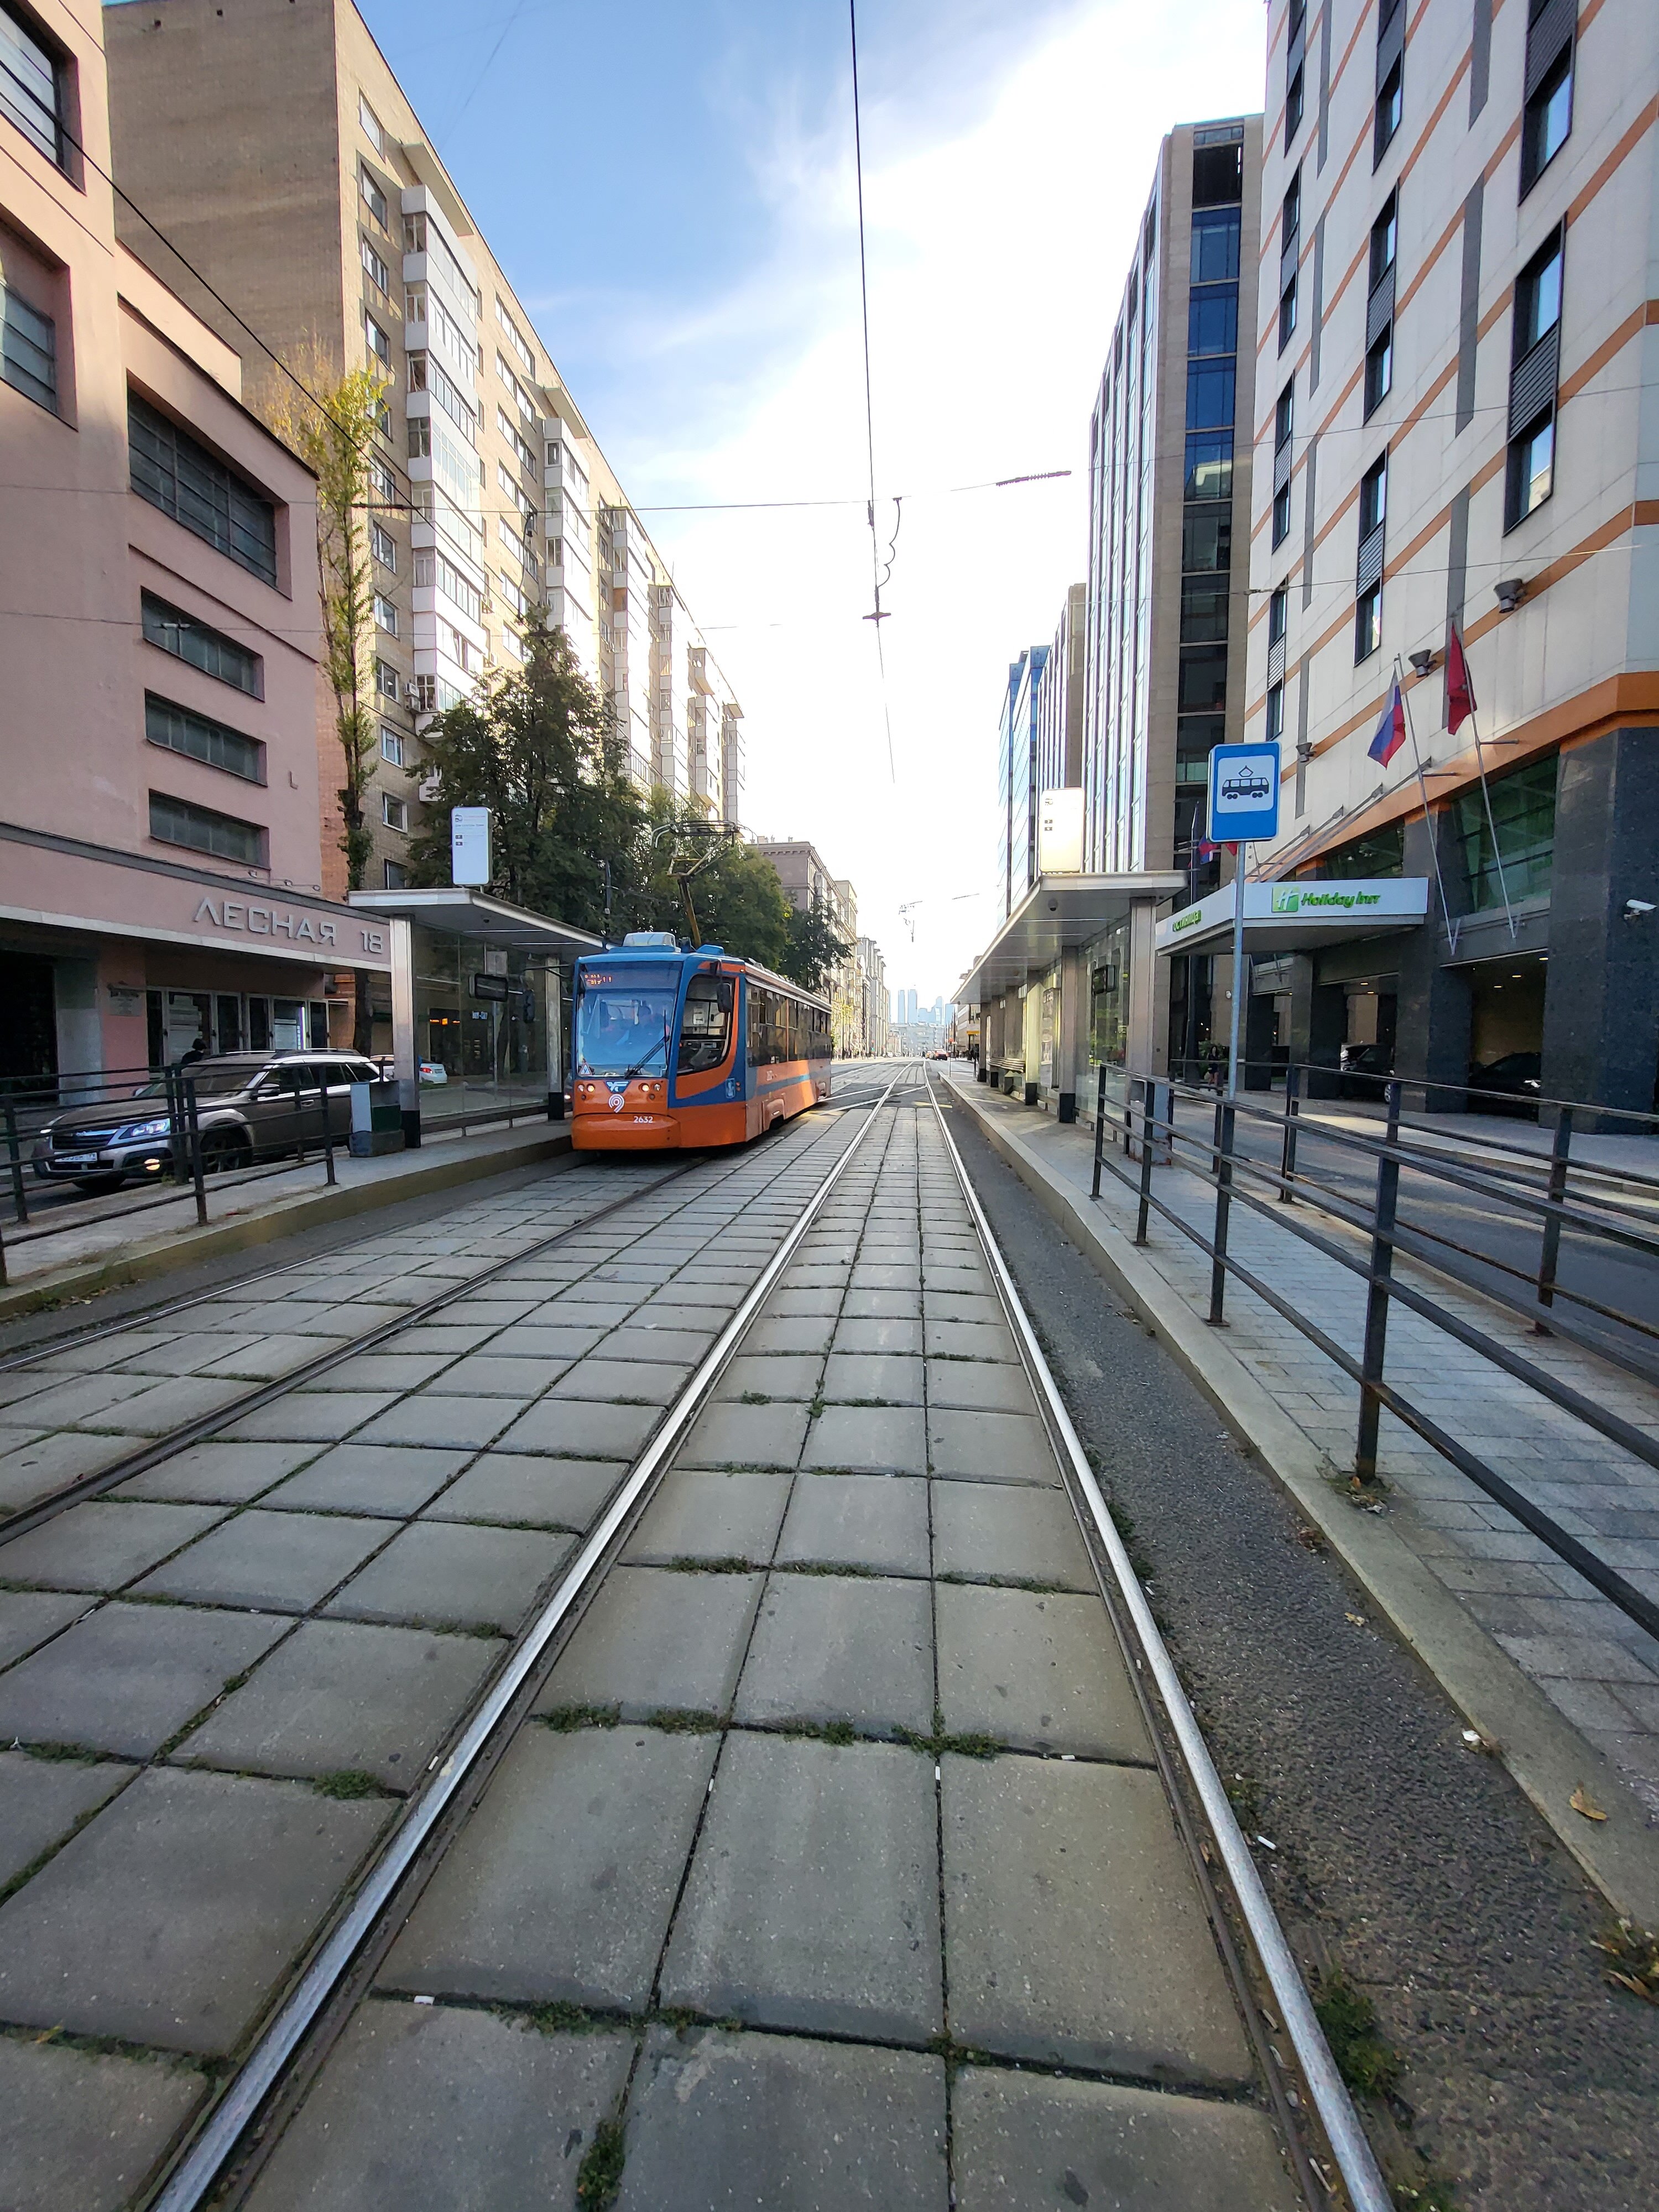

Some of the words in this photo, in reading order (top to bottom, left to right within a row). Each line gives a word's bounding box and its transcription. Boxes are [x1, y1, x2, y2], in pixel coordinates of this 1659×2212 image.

[1301, 891, 1354, 908] Holiday
[1355, 891, 1381, 905] Inn
[194, 897, 336, 946] ЛЕСНАЯ
[361, 930, 384, 953] 18
